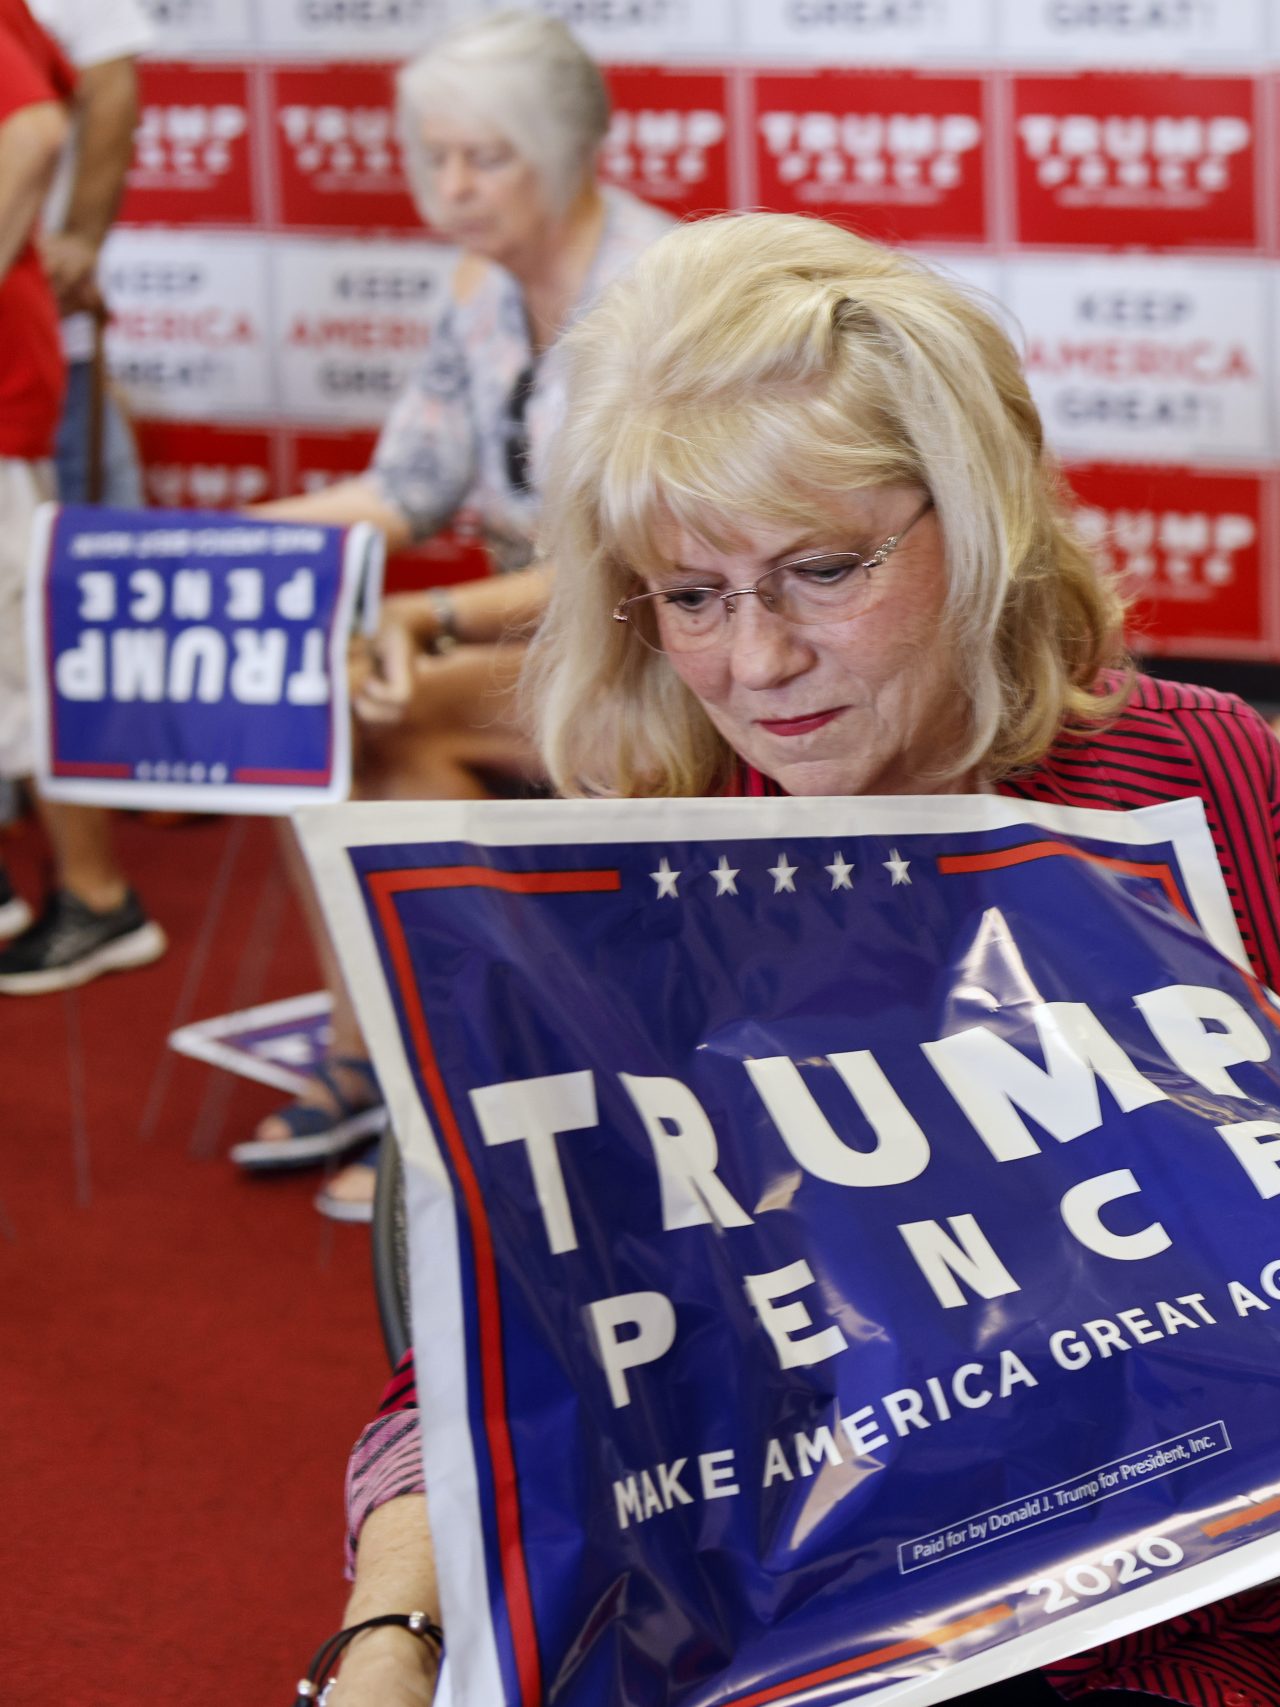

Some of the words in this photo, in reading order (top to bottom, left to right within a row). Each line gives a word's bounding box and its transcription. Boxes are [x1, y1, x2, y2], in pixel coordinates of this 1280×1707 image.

[758, 110, 981, 156] TRUMP
[1018, 114, 1250, 160] TRUMP
[107, 308, 257, 347] MERICA
[288, 314, 428, 352] AMERI
[1076, 295, 1192, 325] KEEP
[1024, 338, 1254, 382] AMERICA
[1076, 508, 1255, 554] RUMP
[78, 567, 315, 622] PENCE
[56, 625, 329, 705] TRUMP
[468, 983, 1272, 1256] TRUMP
[612, 1449, 741, 1530] MAKE
[762, 1350, 1039, 1488] AMERICA
[1049, 1293, 1217, 1371] GREAT
[912, 1535, 945, 1560] Paid
[946, 1529, 968, 1548] for
[968, 1521, 988, 1539] by
[988, 1497, 1041, 1531] Donald
[1041, 1496, 1055, 1512] J.
[1054, 1477, 1100, 1506] Trump
[1097, 1471, 1120, 1490] for
[1119, 1445, 1191, 1481] President,
[1188, 1435, 1217, 1454] Inc.
[1027, 1535, 1185, 1615] 2020
